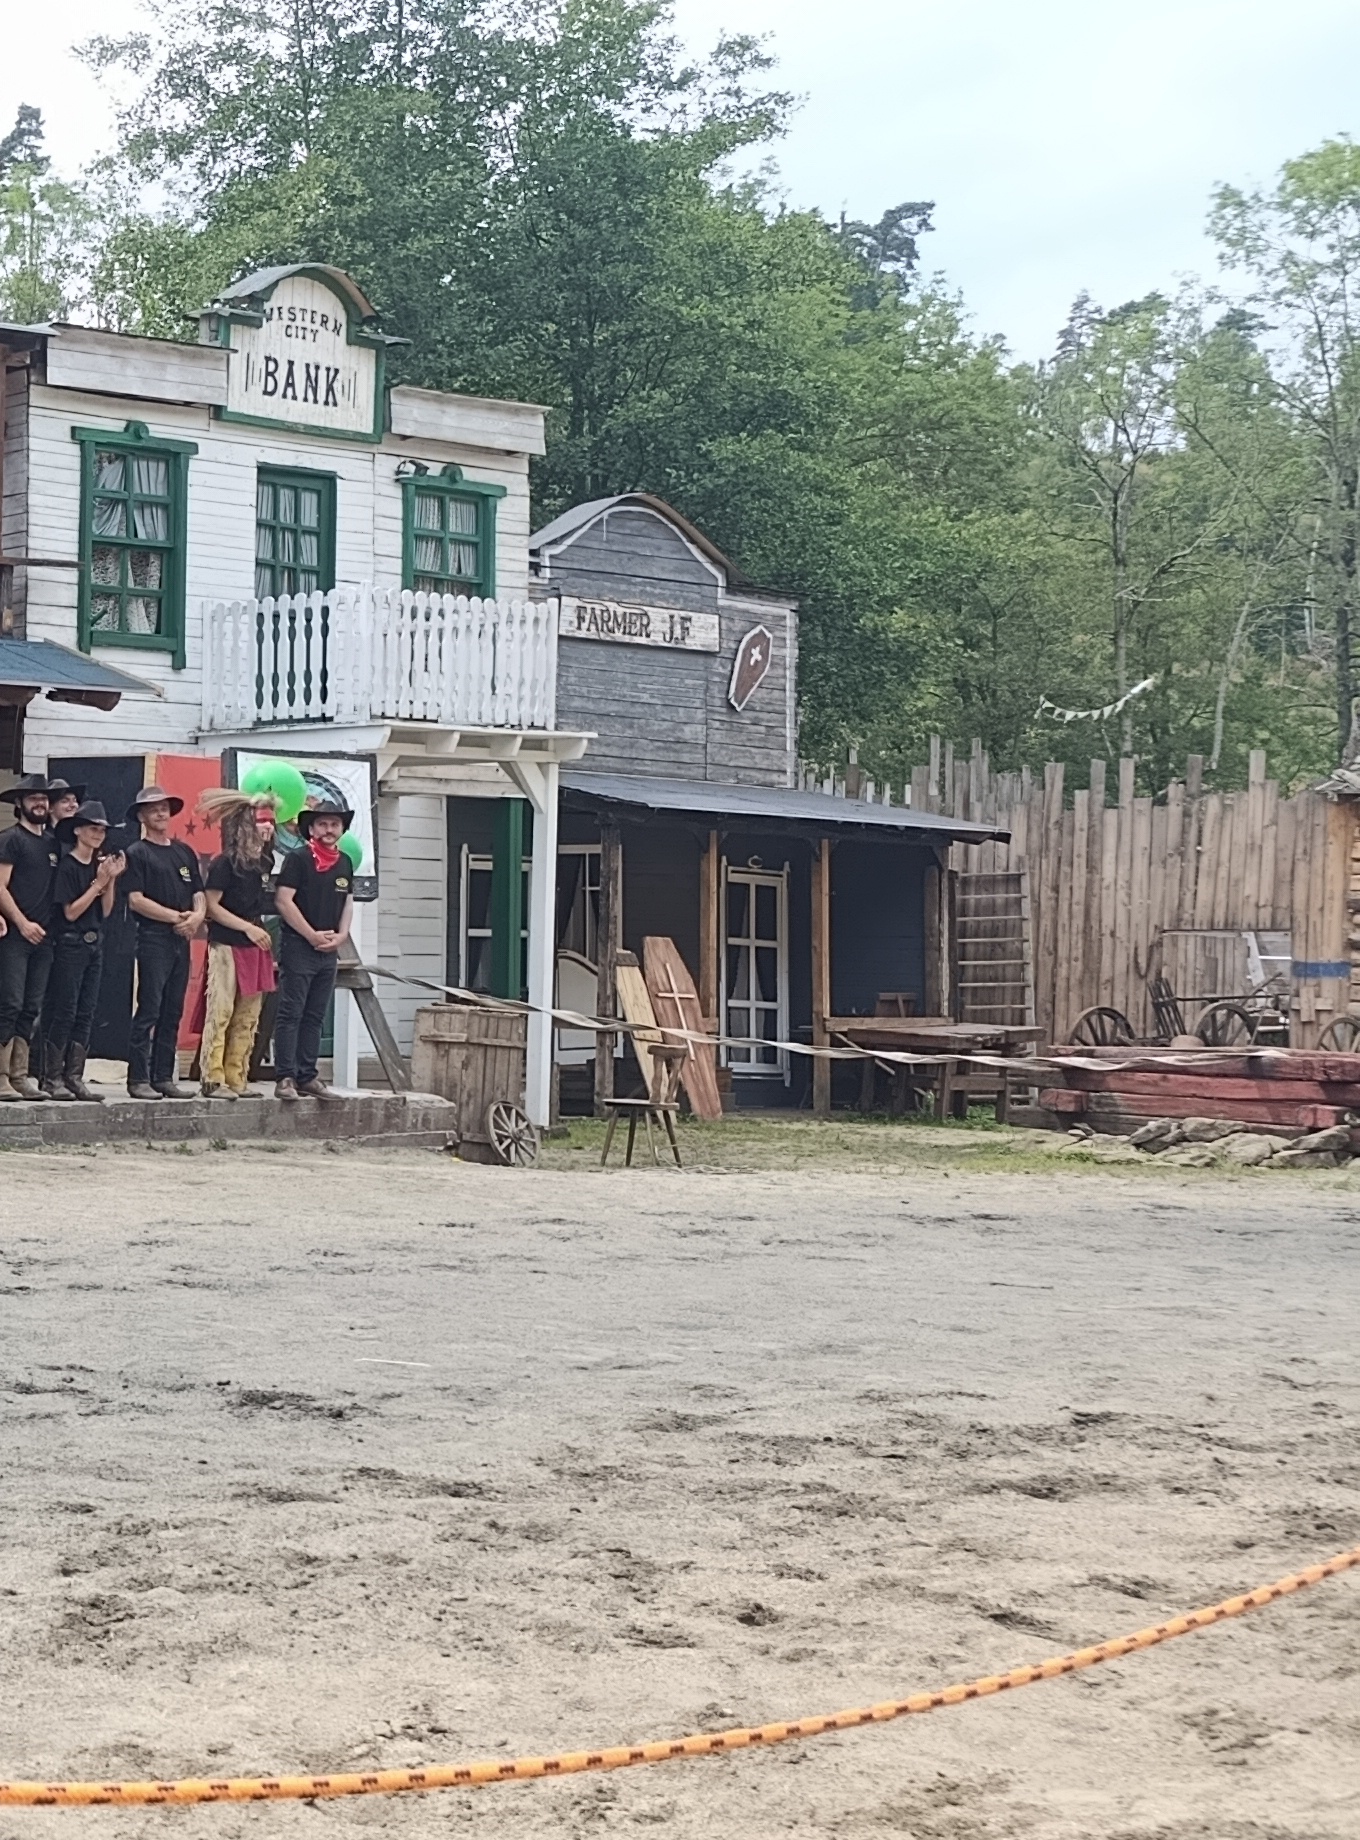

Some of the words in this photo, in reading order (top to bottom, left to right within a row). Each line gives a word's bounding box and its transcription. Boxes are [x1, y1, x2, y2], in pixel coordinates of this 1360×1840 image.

[285, 325, 319, 342] CITY
[262, 354, 340, 408] BANK
[575, 605, 652, 639] FARMER
